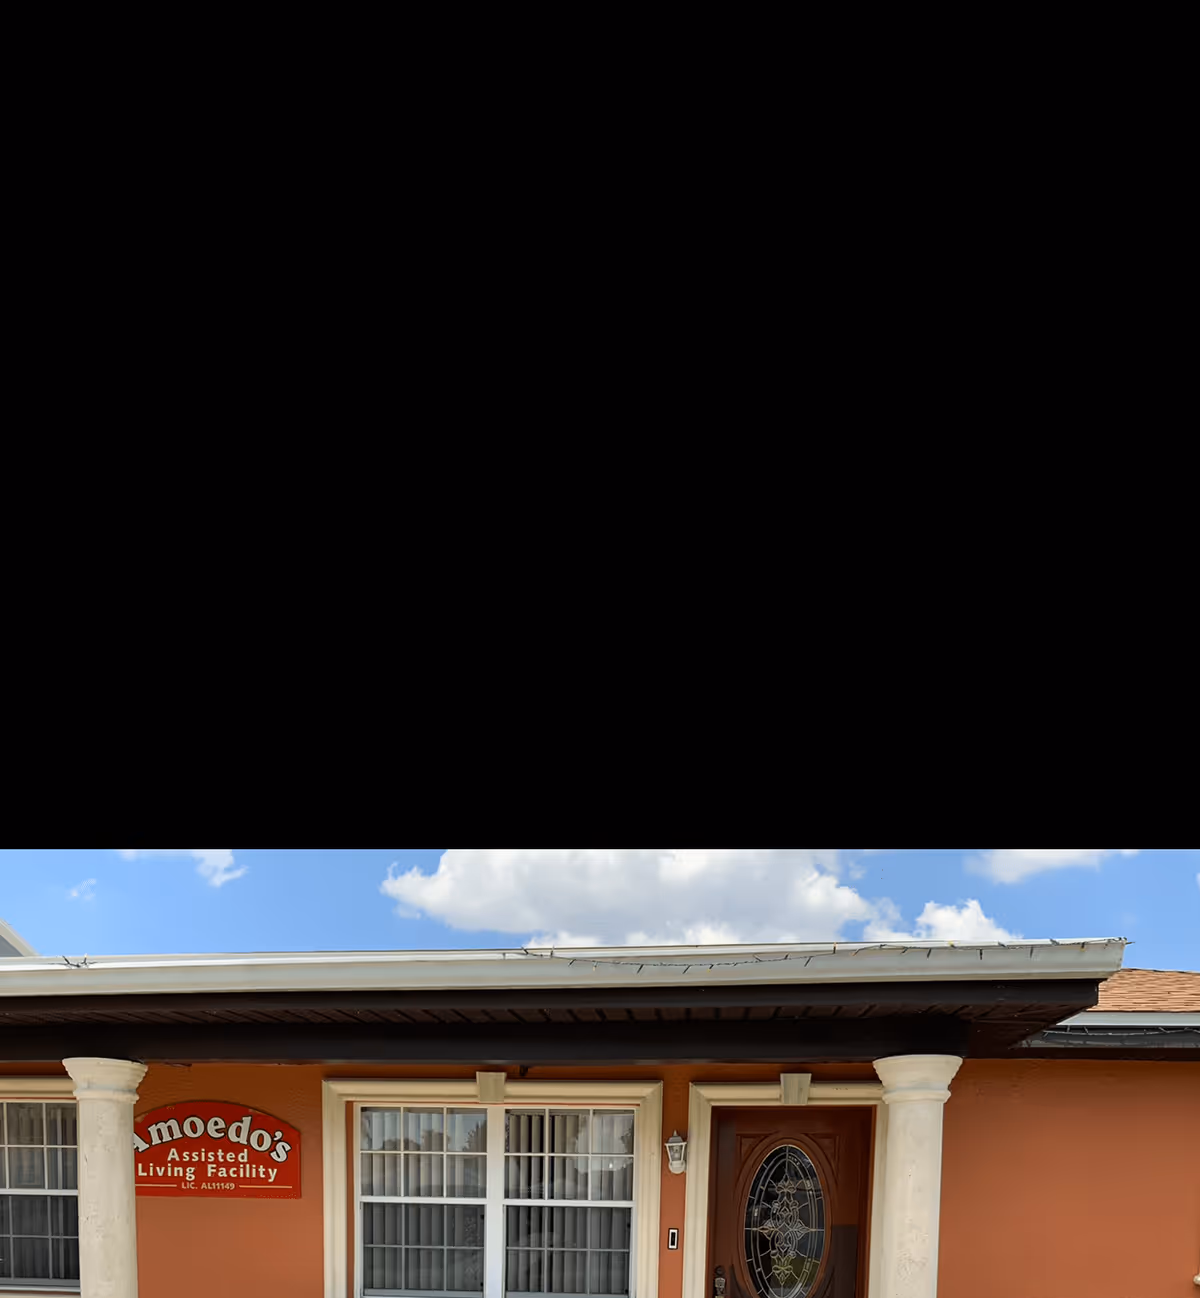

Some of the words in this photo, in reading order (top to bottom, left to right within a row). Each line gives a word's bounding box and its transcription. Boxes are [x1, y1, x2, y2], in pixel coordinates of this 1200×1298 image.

[167, 1148, 248, 1163] Assisted
[138, 1163, 196, 1181] Living
[207, 1164, 278, 1182] Facility
[181, 1182, 198, 1190] LIC.
